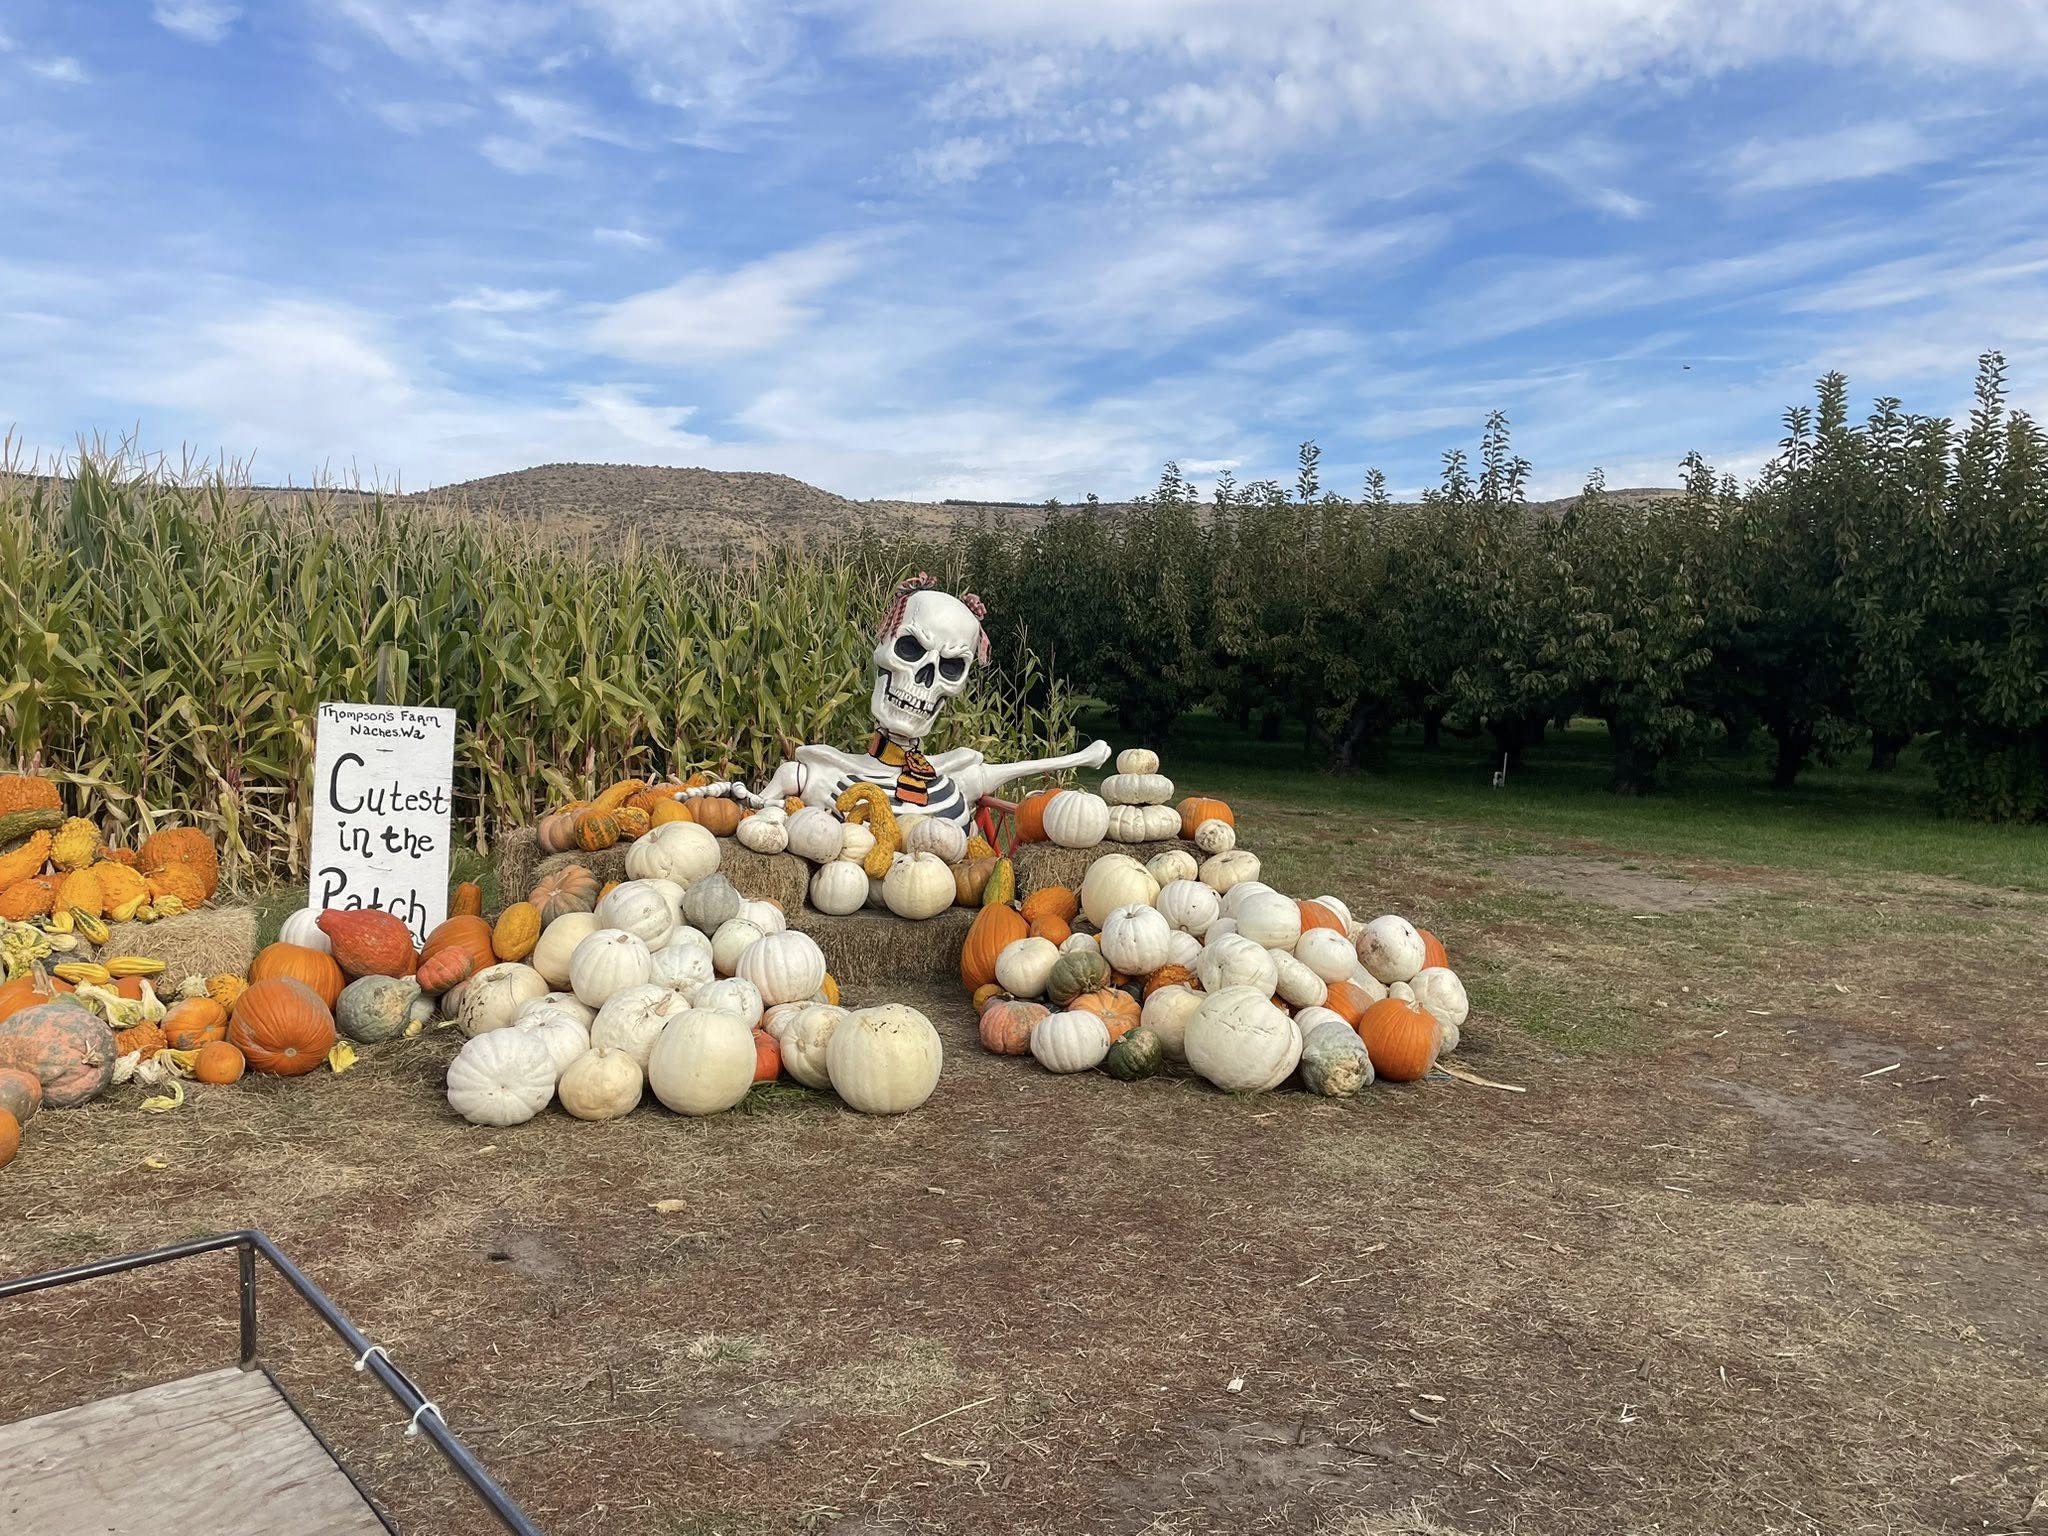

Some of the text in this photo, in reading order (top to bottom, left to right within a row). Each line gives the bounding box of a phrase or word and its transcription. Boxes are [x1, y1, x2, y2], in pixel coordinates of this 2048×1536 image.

[320, 704, 395, 724] Thompson's
[329, 752, 449, 816] Cutest
[338, 821, 435, 859] in the
[318, 866, 426, 943] Patch
